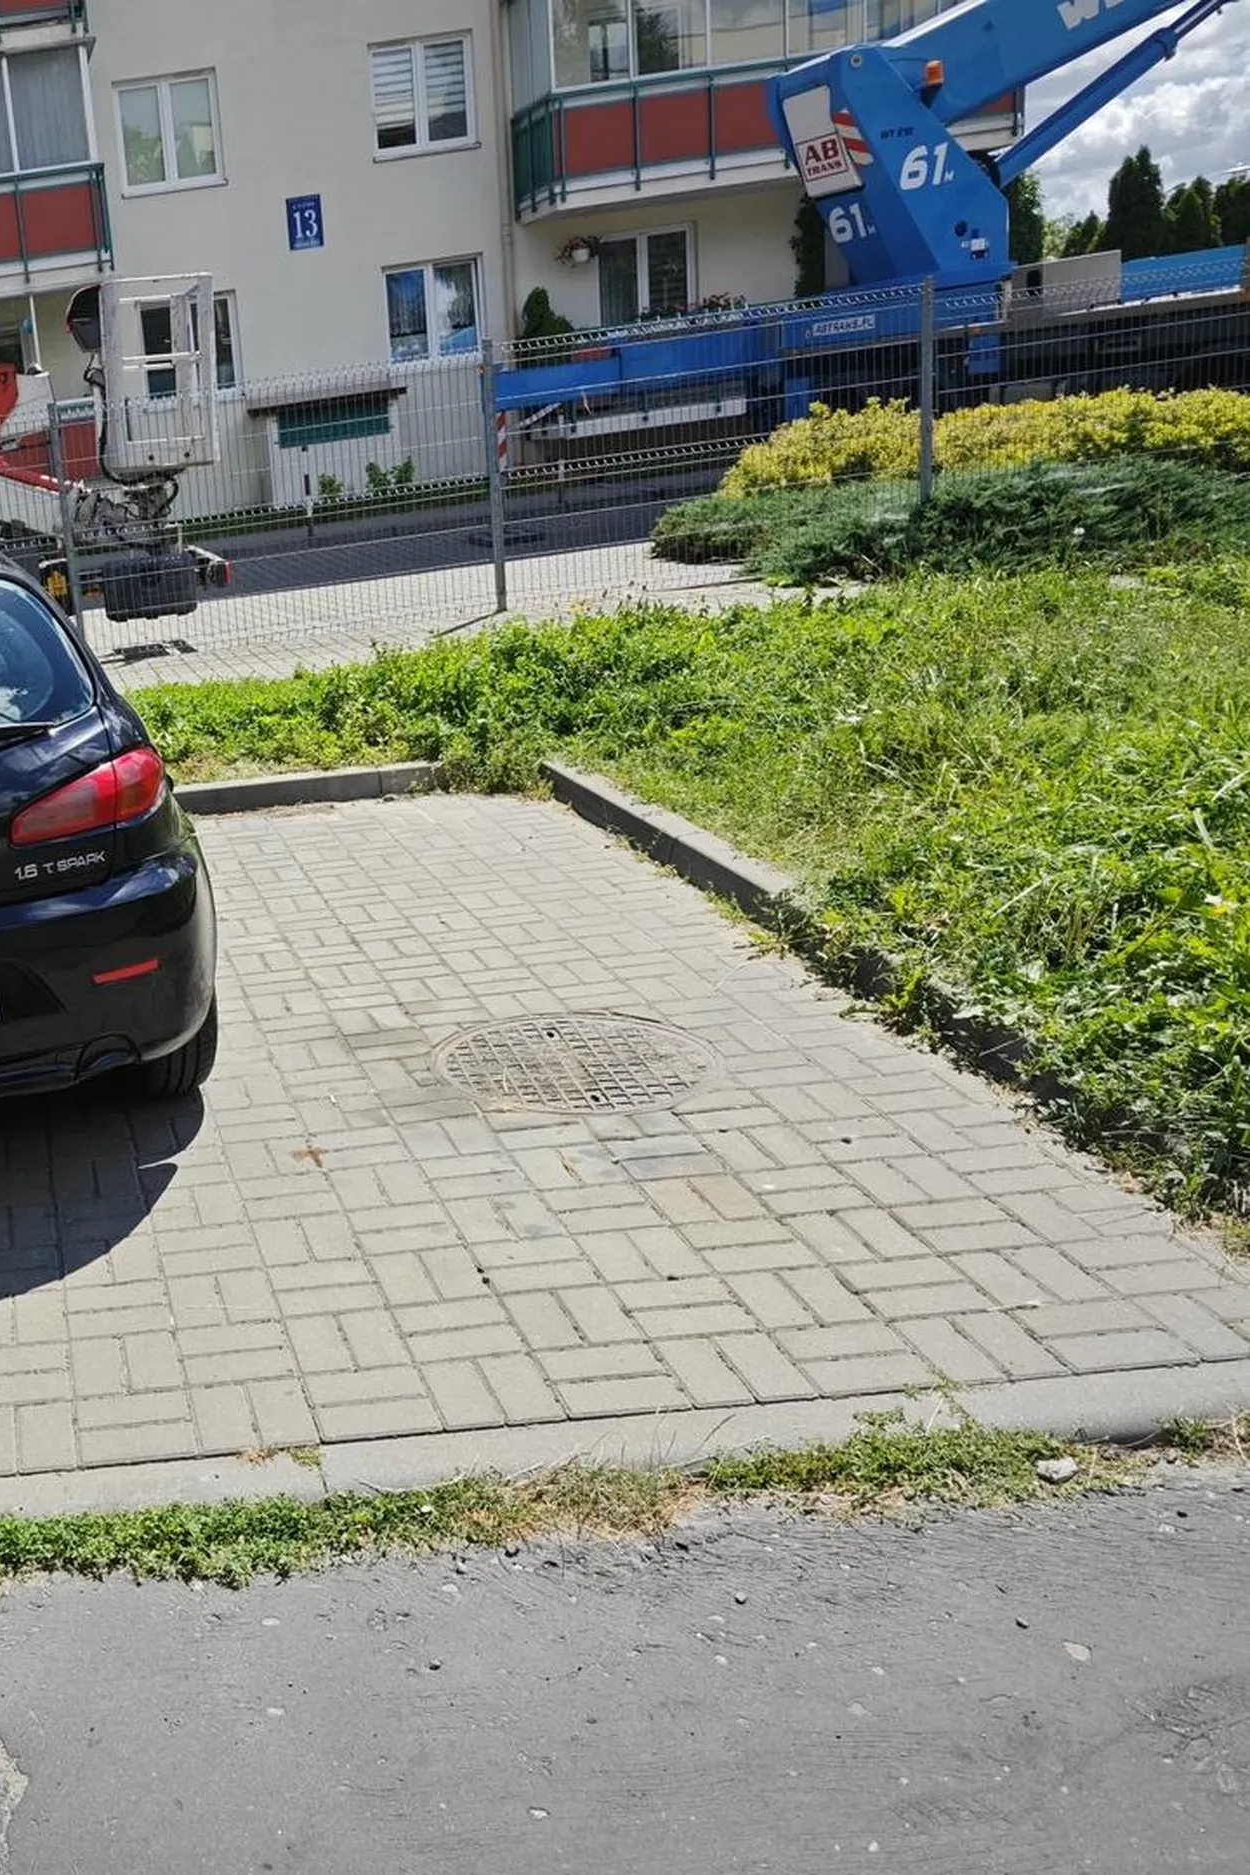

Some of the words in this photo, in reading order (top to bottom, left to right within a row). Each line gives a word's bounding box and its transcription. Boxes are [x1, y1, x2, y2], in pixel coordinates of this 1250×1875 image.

[805, 139, 839, 165] AB
[807, 160, 842, 176] TRANS
[293, 209, 318, 239] 13
[56, 851, 106, 872] SPARK
